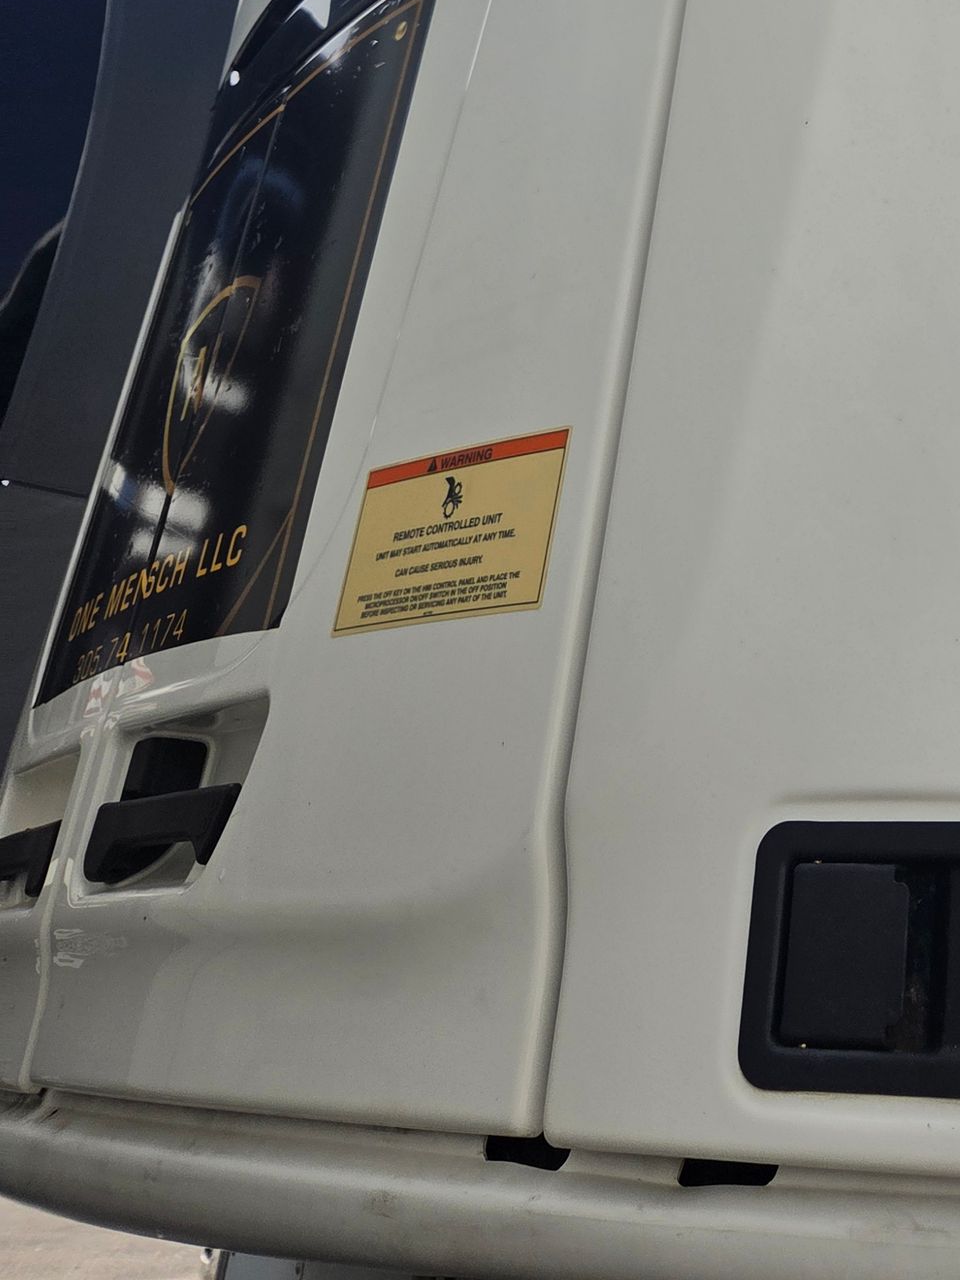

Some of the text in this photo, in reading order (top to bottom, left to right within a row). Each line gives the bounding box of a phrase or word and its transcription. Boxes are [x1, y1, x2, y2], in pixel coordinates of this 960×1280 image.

[440, 448, 493, 469] WARNING
[393, 512, 503, 542] REMOTE CONTROLLED UNIT
[376, 528, 516, 561] UNIT MAY START AUTOMATICALLY AT ANY TIME.
[395, 567, 409, 578] CAN
[408, 563, 429, 575] CAUSE
[430, 558, 458, 572] SERIOUS
[68, 524, 248, 642] ONE MENSCH LLC
[432, 580, 457, 590] CONTROL
[458, 576, 475, 585] PANEL
[476, 575, 488, 583] AND
[489, 572, 507, 581] PLACE
[509, 570, 520, 579] THE
[457, 587, 467, 595] THE
[480, 581, 507, 592] POSITION
[481, 592, 491, 600] THE
